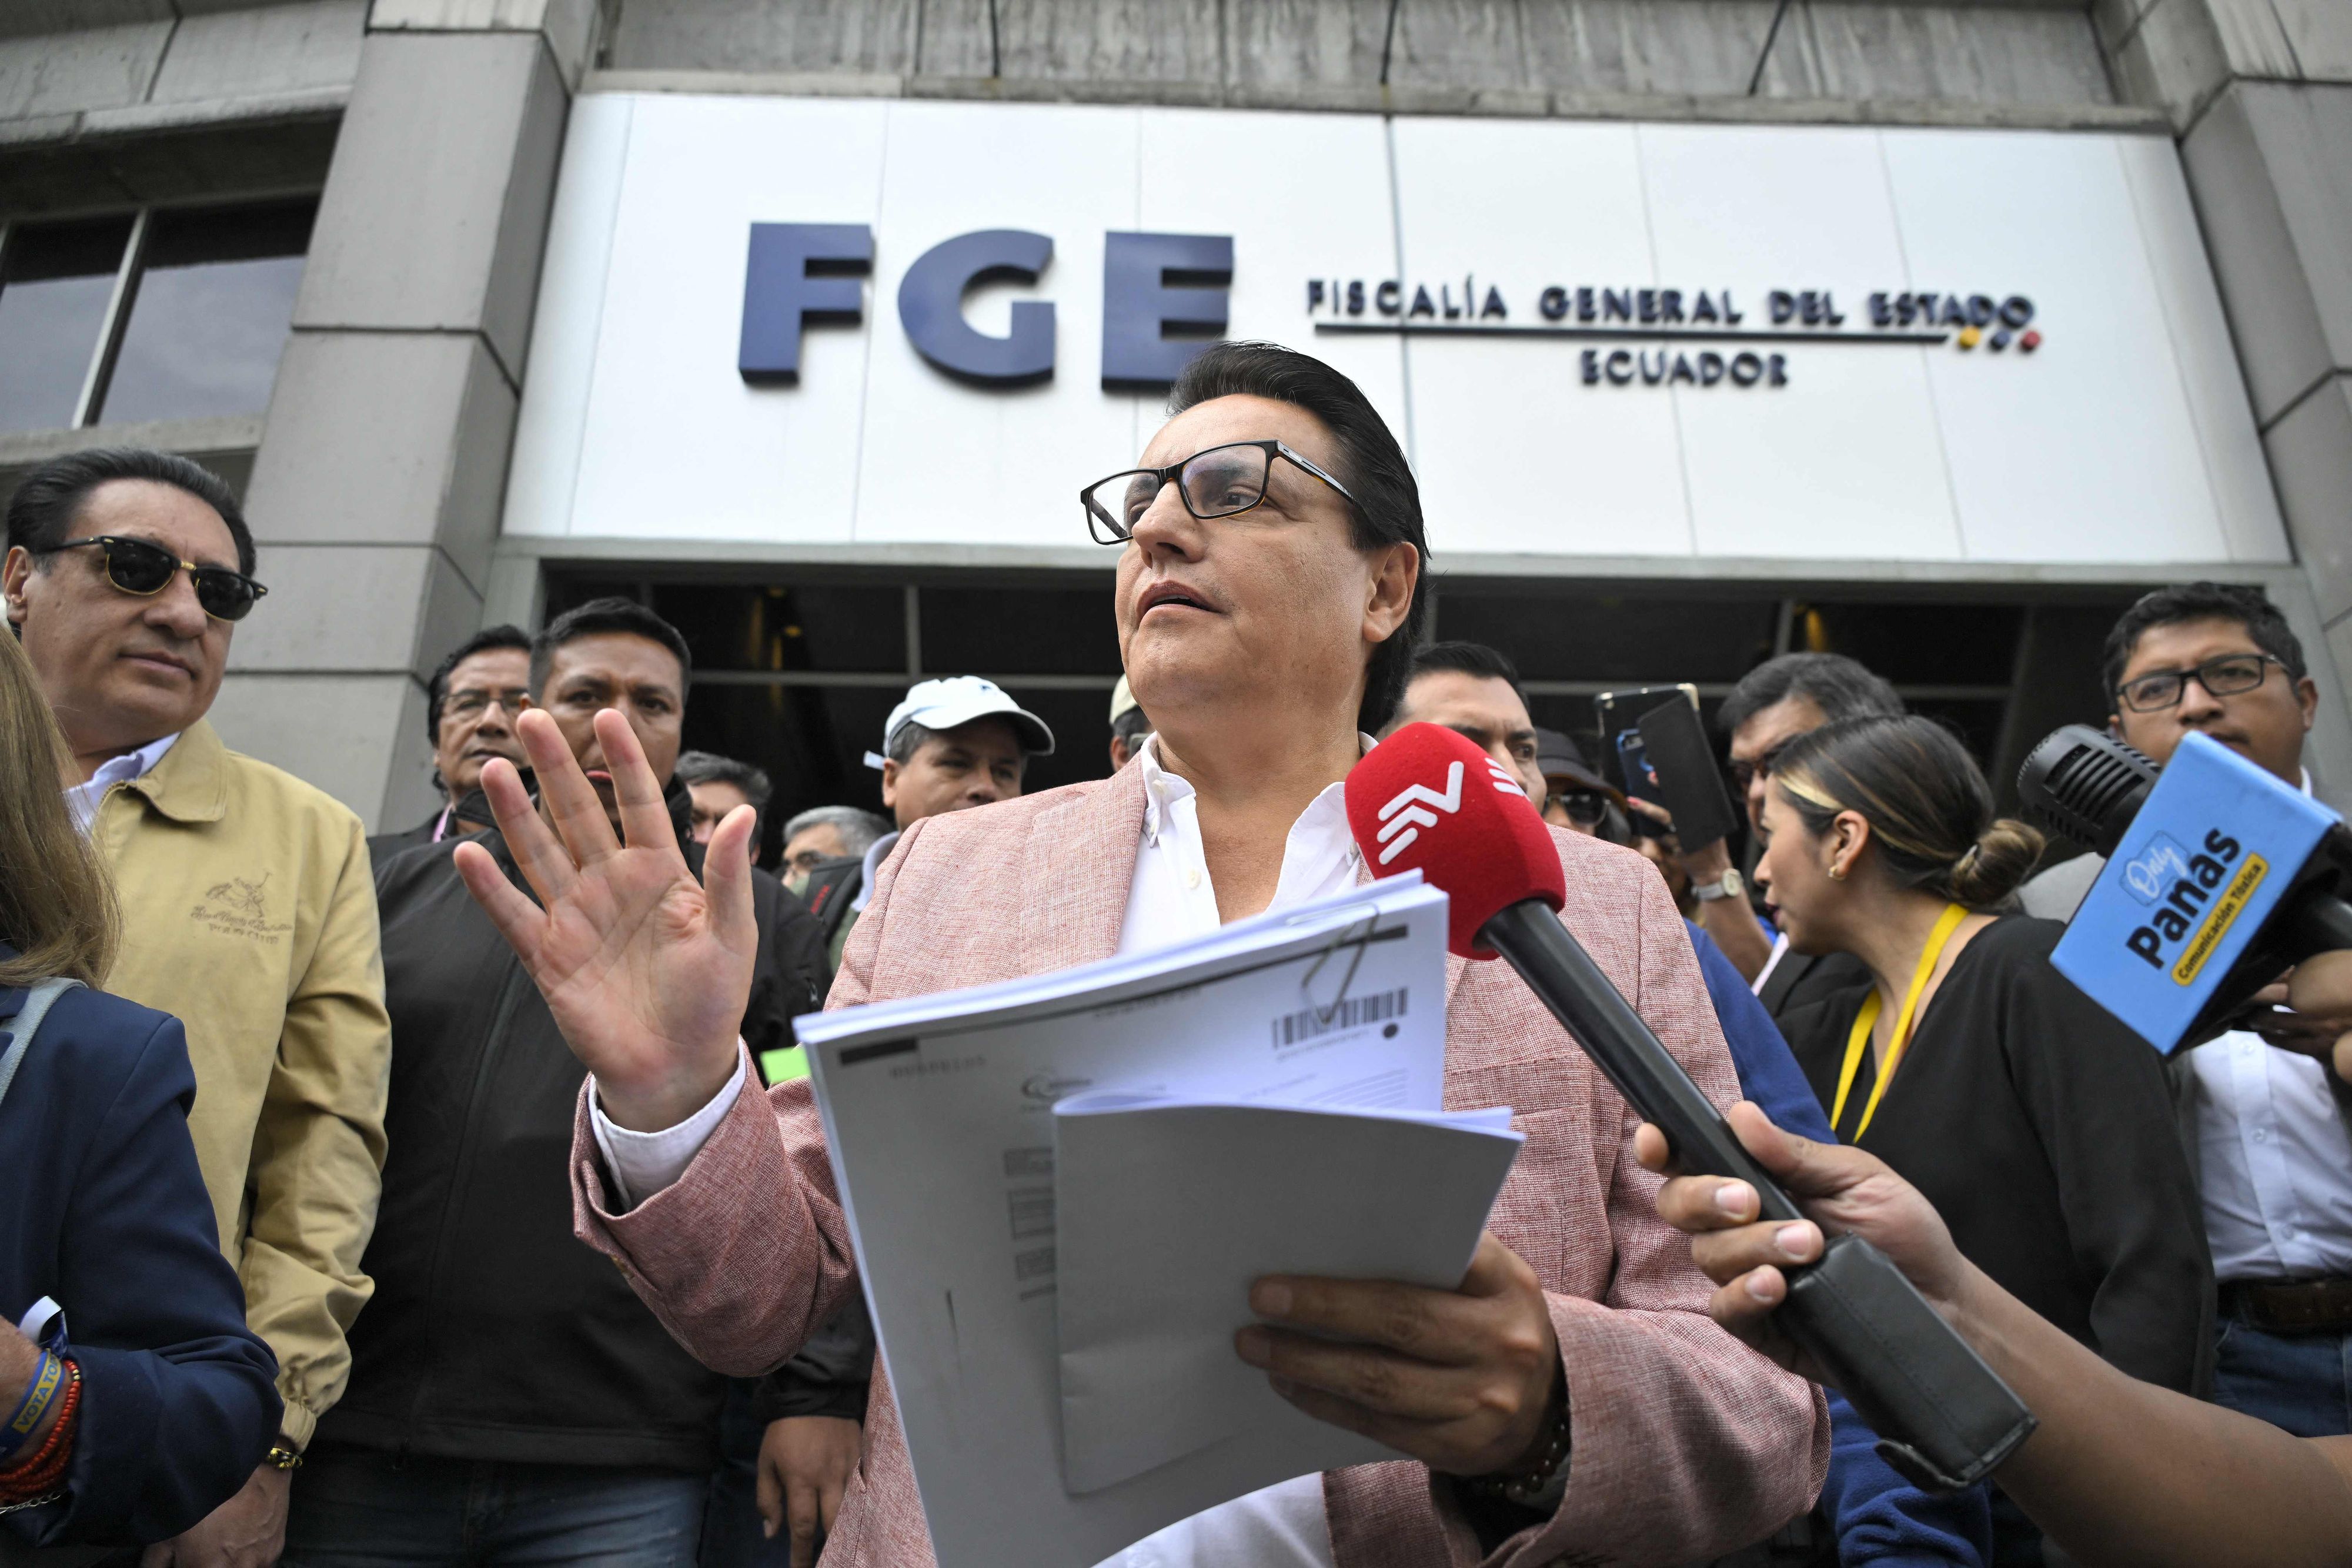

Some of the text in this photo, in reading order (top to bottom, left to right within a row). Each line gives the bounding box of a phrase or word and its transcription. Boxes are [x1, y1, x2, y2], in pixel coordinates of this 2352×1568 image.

[739, 222, 1234, 393] FGE
[1307, 273, 2035, 329] FISCALÍA GENERAL DEL ESTADO
[1581, 350, 1789, 388] ECUADOR
[2126, 845, 2188, 899] Only
[2126, 827, 2240, 971] Panas
[2178, 902, 2235, 979] Comunicación
[18, 1388, 51, 1425] VOTA
